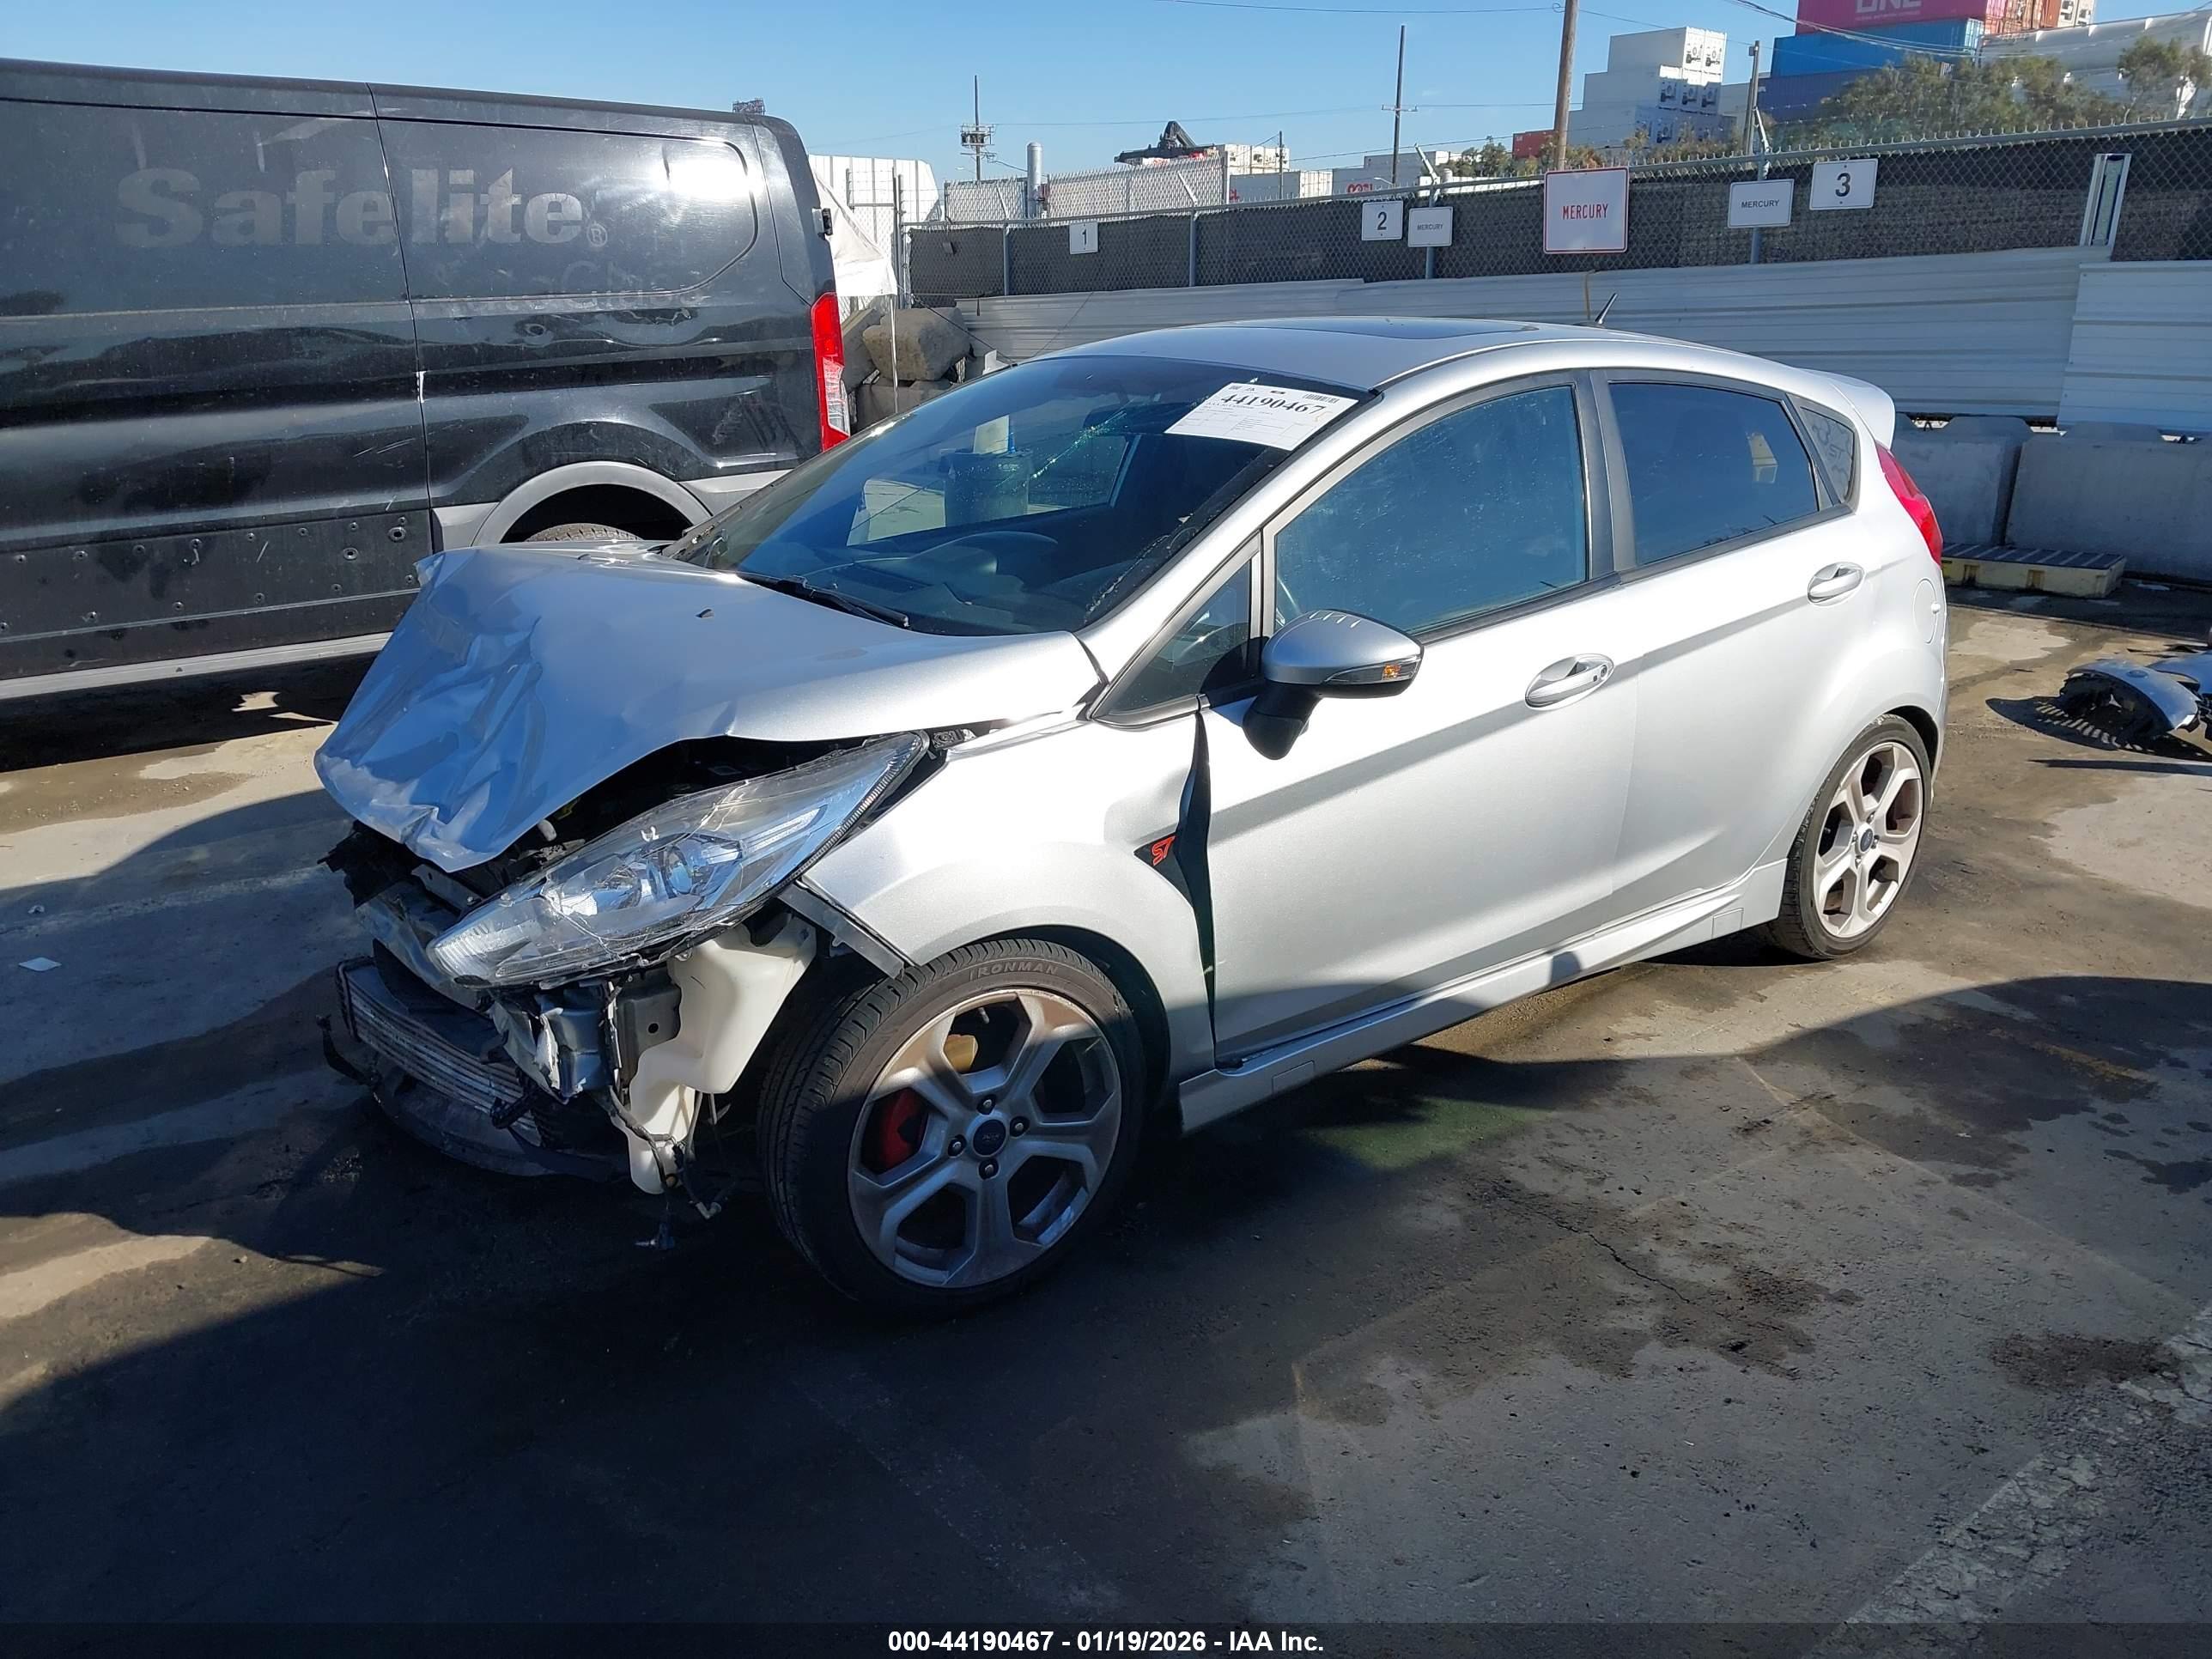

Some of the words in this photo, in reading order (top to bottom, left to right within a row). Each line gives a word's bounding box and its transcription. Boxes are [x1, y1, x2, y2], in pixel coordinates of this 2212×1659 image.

[1835, 172, 1851, 198] 3
[1563, 203, 1608, 221] MERCURY
[1741, 199, 1780, 209] MERCURY
[1377, 211, 1387, 231] 2
[1416, 222, 1444, 232] MERCURY
[1082, 228, 1087, 246] 1
[1220, 392, 1327, 416] 44190467
[1152, 835, 1176, 866] ST
[969, 961, 1058, 981] IRONMAN
